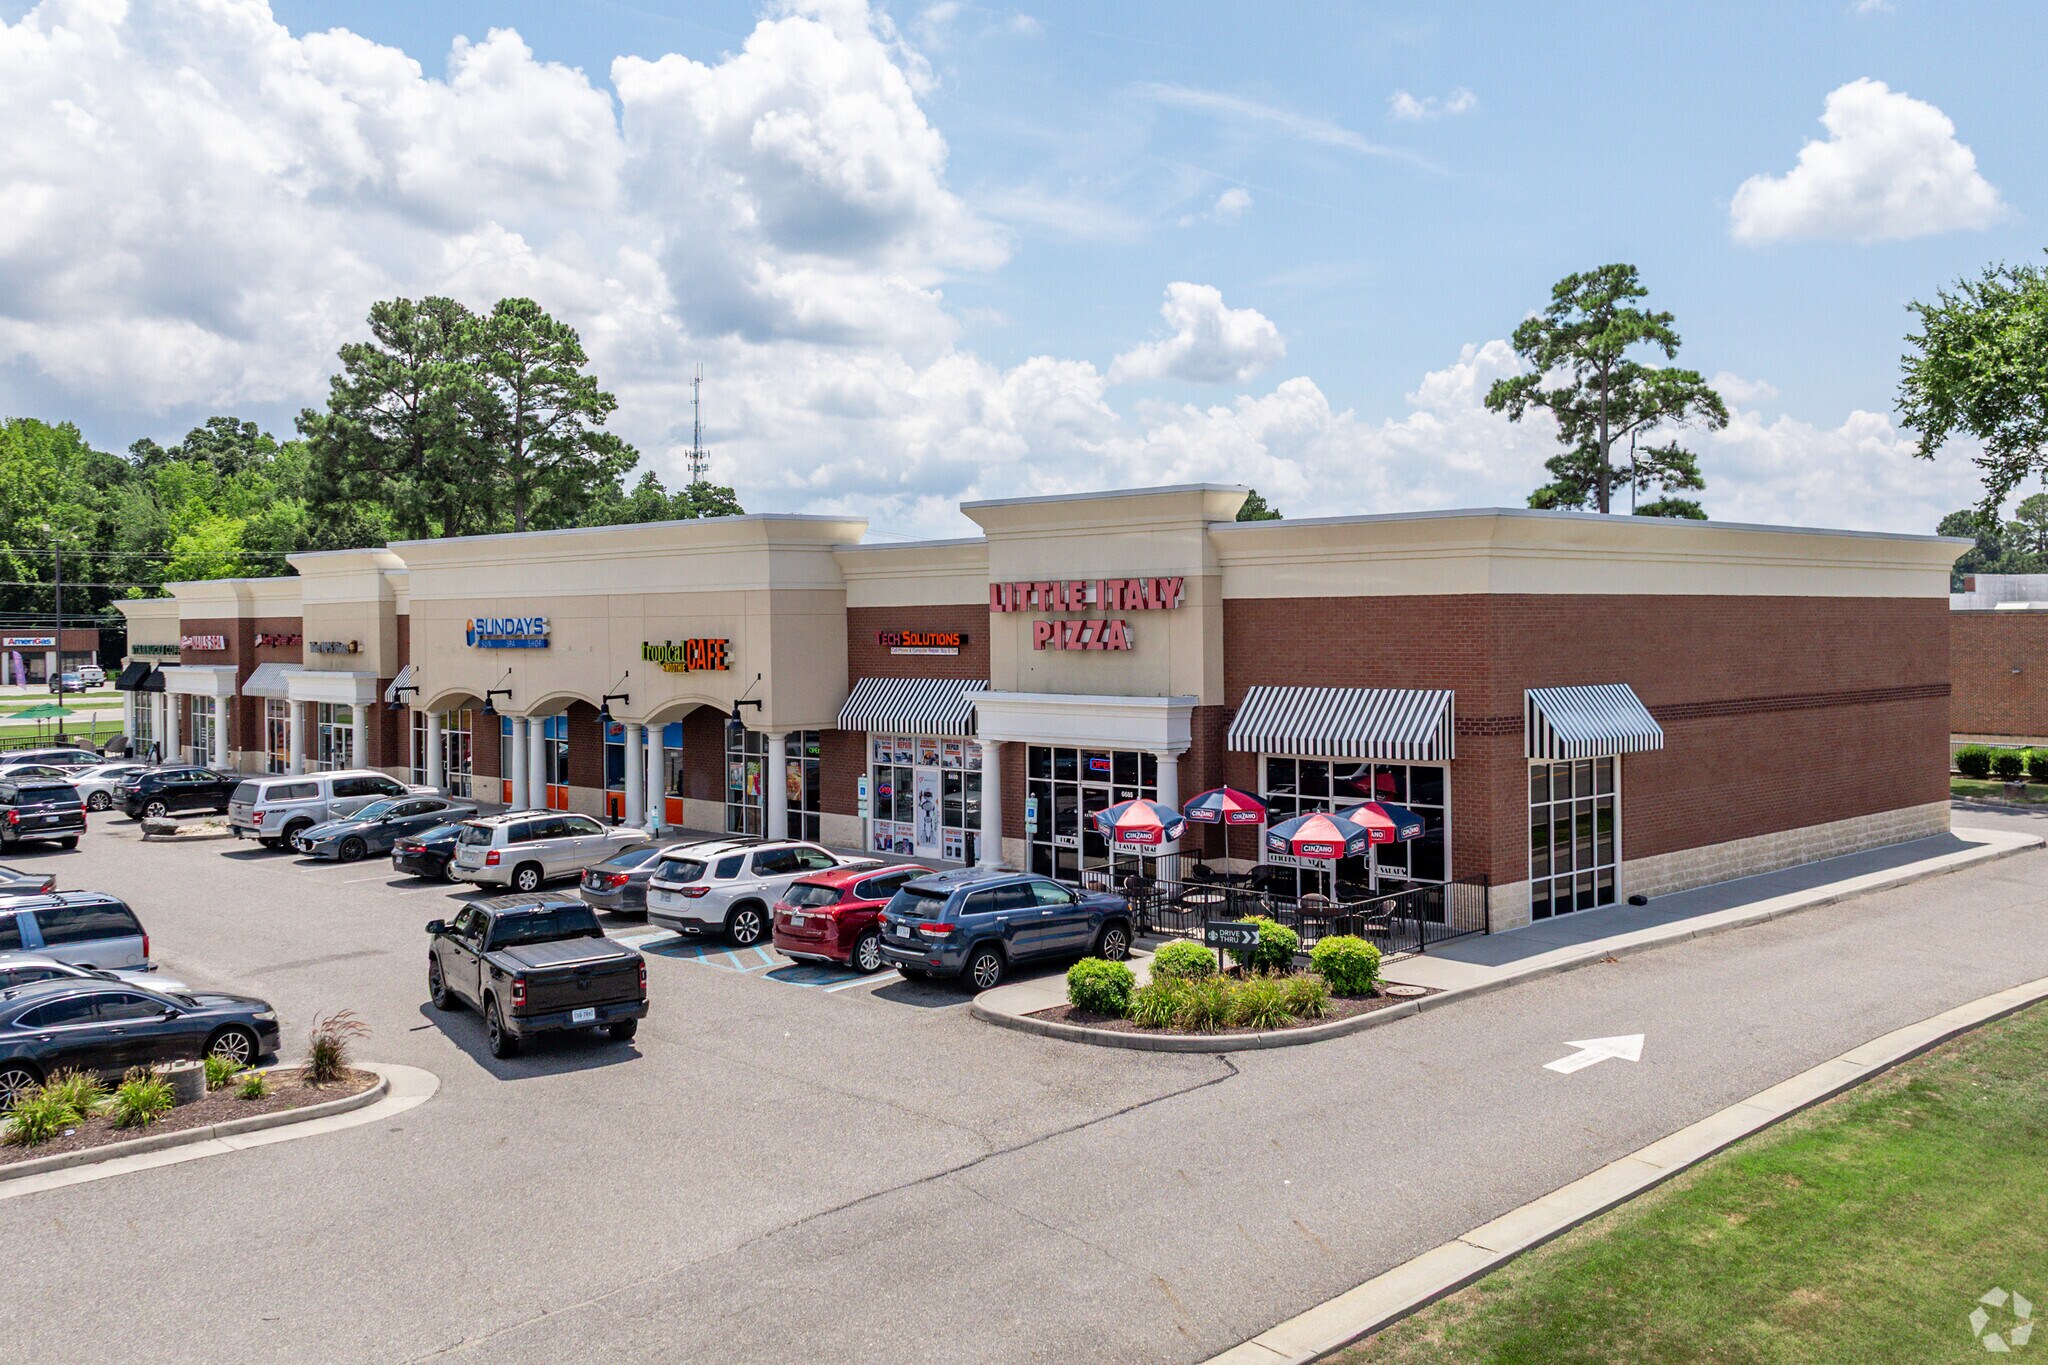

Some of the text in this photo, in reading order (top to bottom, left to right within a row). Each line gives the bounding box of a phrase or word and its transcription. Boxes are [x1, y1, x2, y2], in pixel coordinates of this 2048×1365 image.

[989, 577, 1183, 612] LITTLE ITALY
[476, 617, 543, 635] SUNDAYS
[875, 630, 960, 646] TECH SOLUTIONS
[1033, 620, 1131, 650] PIZZA
[481, 640, 542, 648] SUN SPA SHOP
[641, 638, 728, 671] tropical CAFE
[1232, 812, 1256, 820] CINZANO
[1125, 831, 1152, 840] CINZANO
[1303, 844, 1333, 853] CINZANO
